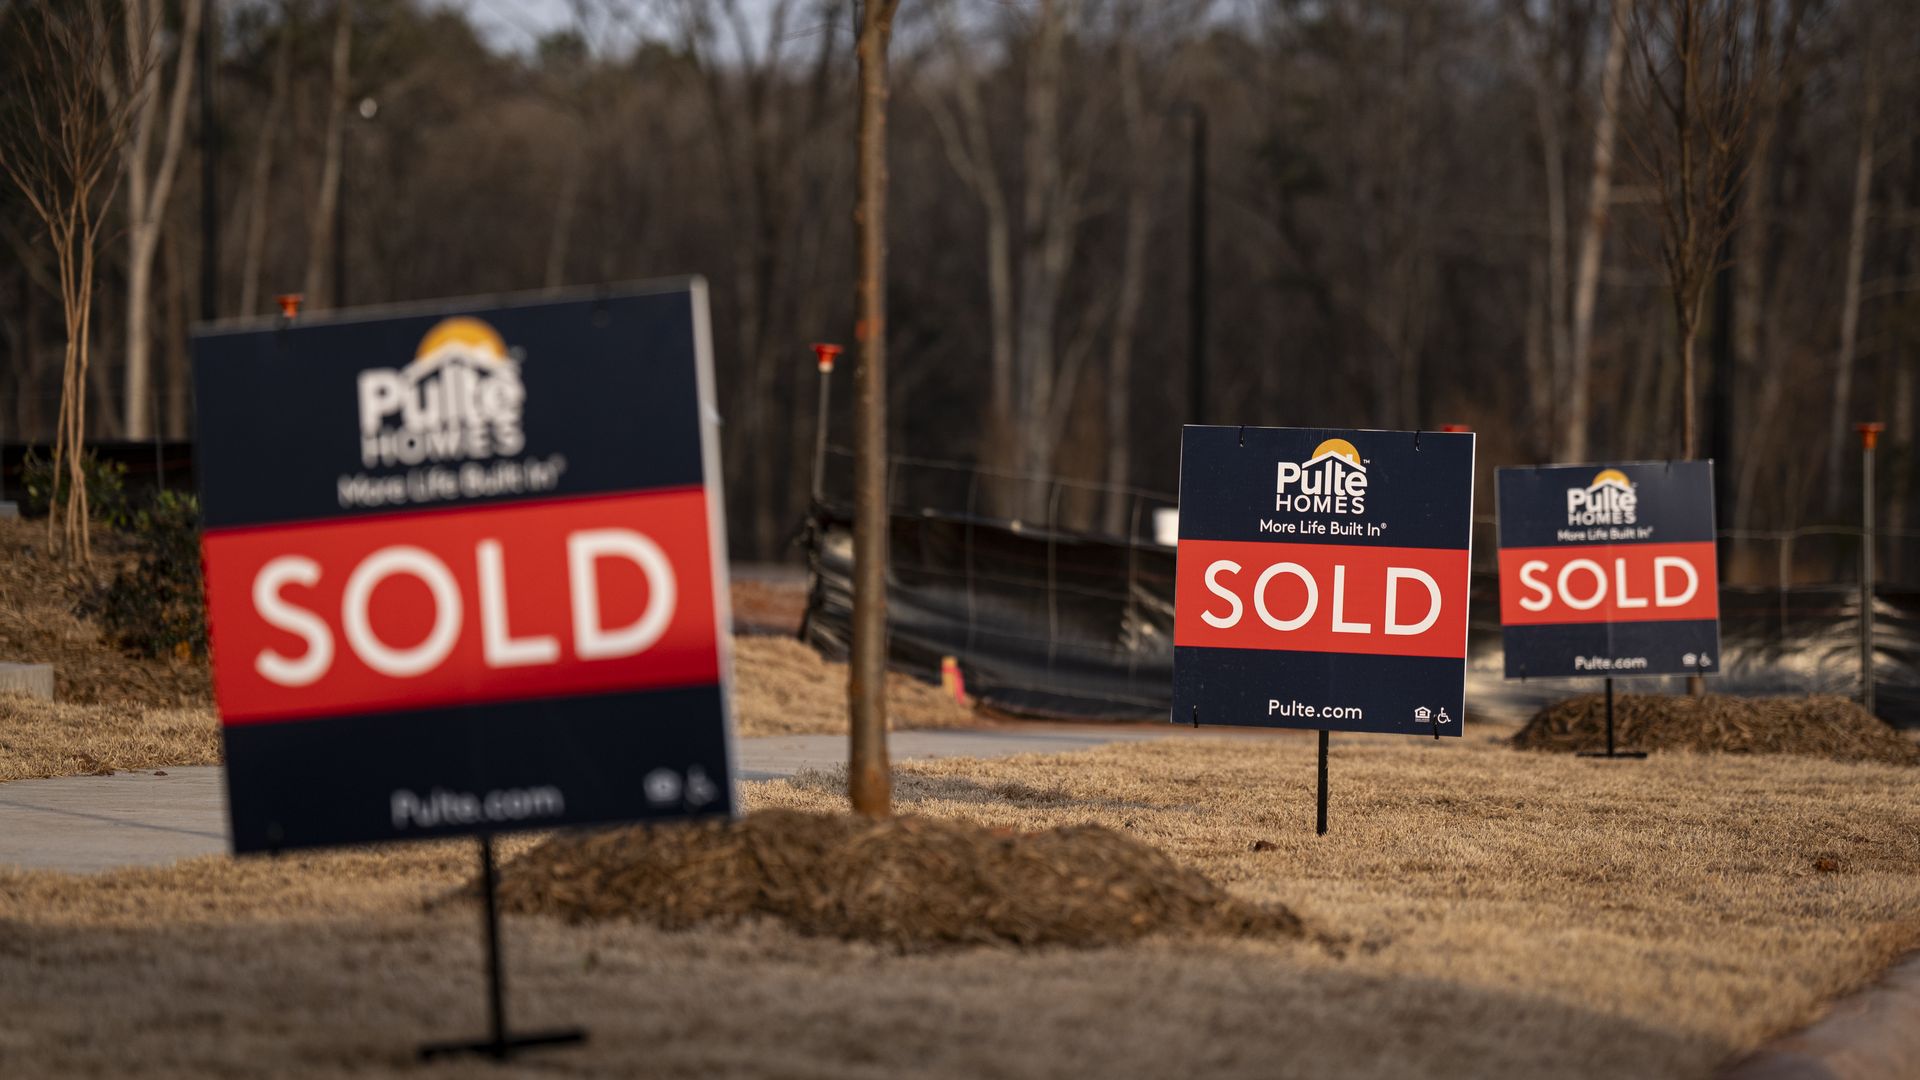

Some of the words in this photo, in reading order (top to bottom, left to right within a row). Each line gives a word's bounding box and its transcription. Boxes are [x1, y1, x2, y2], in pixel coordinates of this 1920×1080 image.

[357, 358, 526, 436] Pulte
[361, 426, 526, 468] HOMES
[1276, 459, 1368, 497] Pulte
[1275, 494, 1365, 515] HOMES
[1567, 486, 1637, 514] Pulte
[1259, 518, 1296, 533] More
[1300, 520, 1326, 535] Life
[1330, 521, 1363, 536] Built
[1557, 529, 1586, 541] More
[1587, 528, 1608, 540] Life
[1610, 526, 1635, 540] Built
[1568, 511, 1637, 526] HOMES
[1200, 559, 1442, 636] SOLD
[1519, 556, 1699, 612] SOLD
[252, 527, 677, 687] SOLD
[1574, 655, 1648, 671] Pulte.com
[1268, 699, 1363, 720] Pulte.com
[390, 784, 565, 828] Pulte.com
